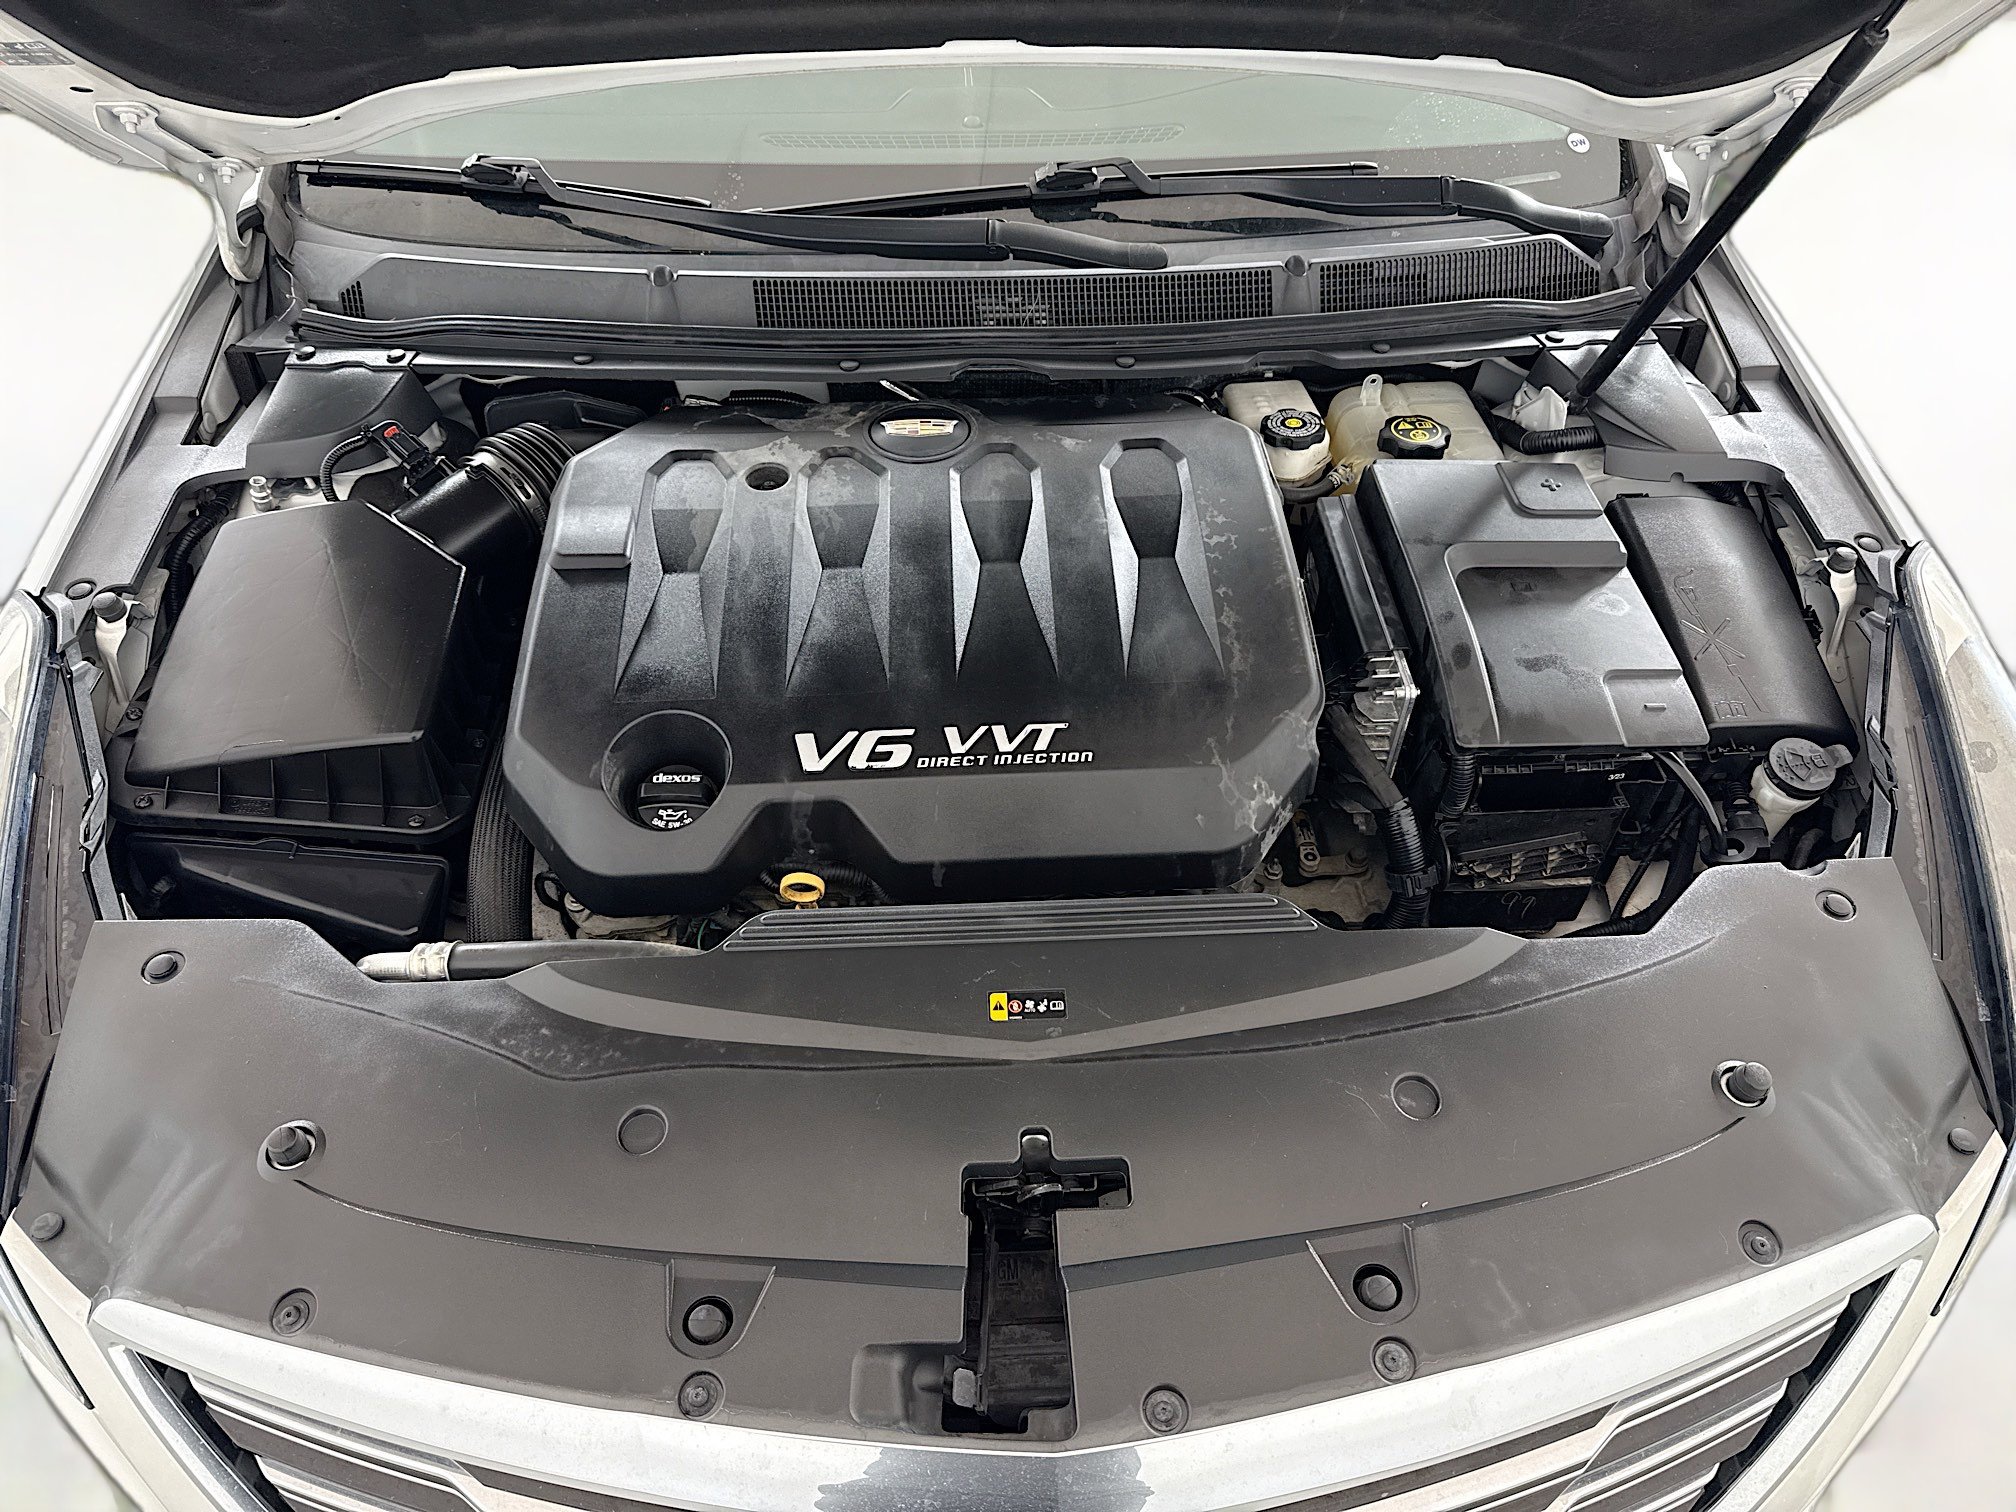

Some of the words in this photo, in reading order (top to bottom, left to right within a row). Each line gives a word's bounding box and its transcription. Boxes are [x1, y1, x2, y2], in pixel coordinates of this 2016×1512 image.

[1570, 138, 1586, 147] DW
[794, 728, 916, 772] V6
[943, 722, 1069, 754] VVT
[916, 755, 989, 768] DIRECT
[993, 752, 1093, 765] INJECTION
[652, 773, 703, 783] dexos
[651, 818, 667, 828] SAE
